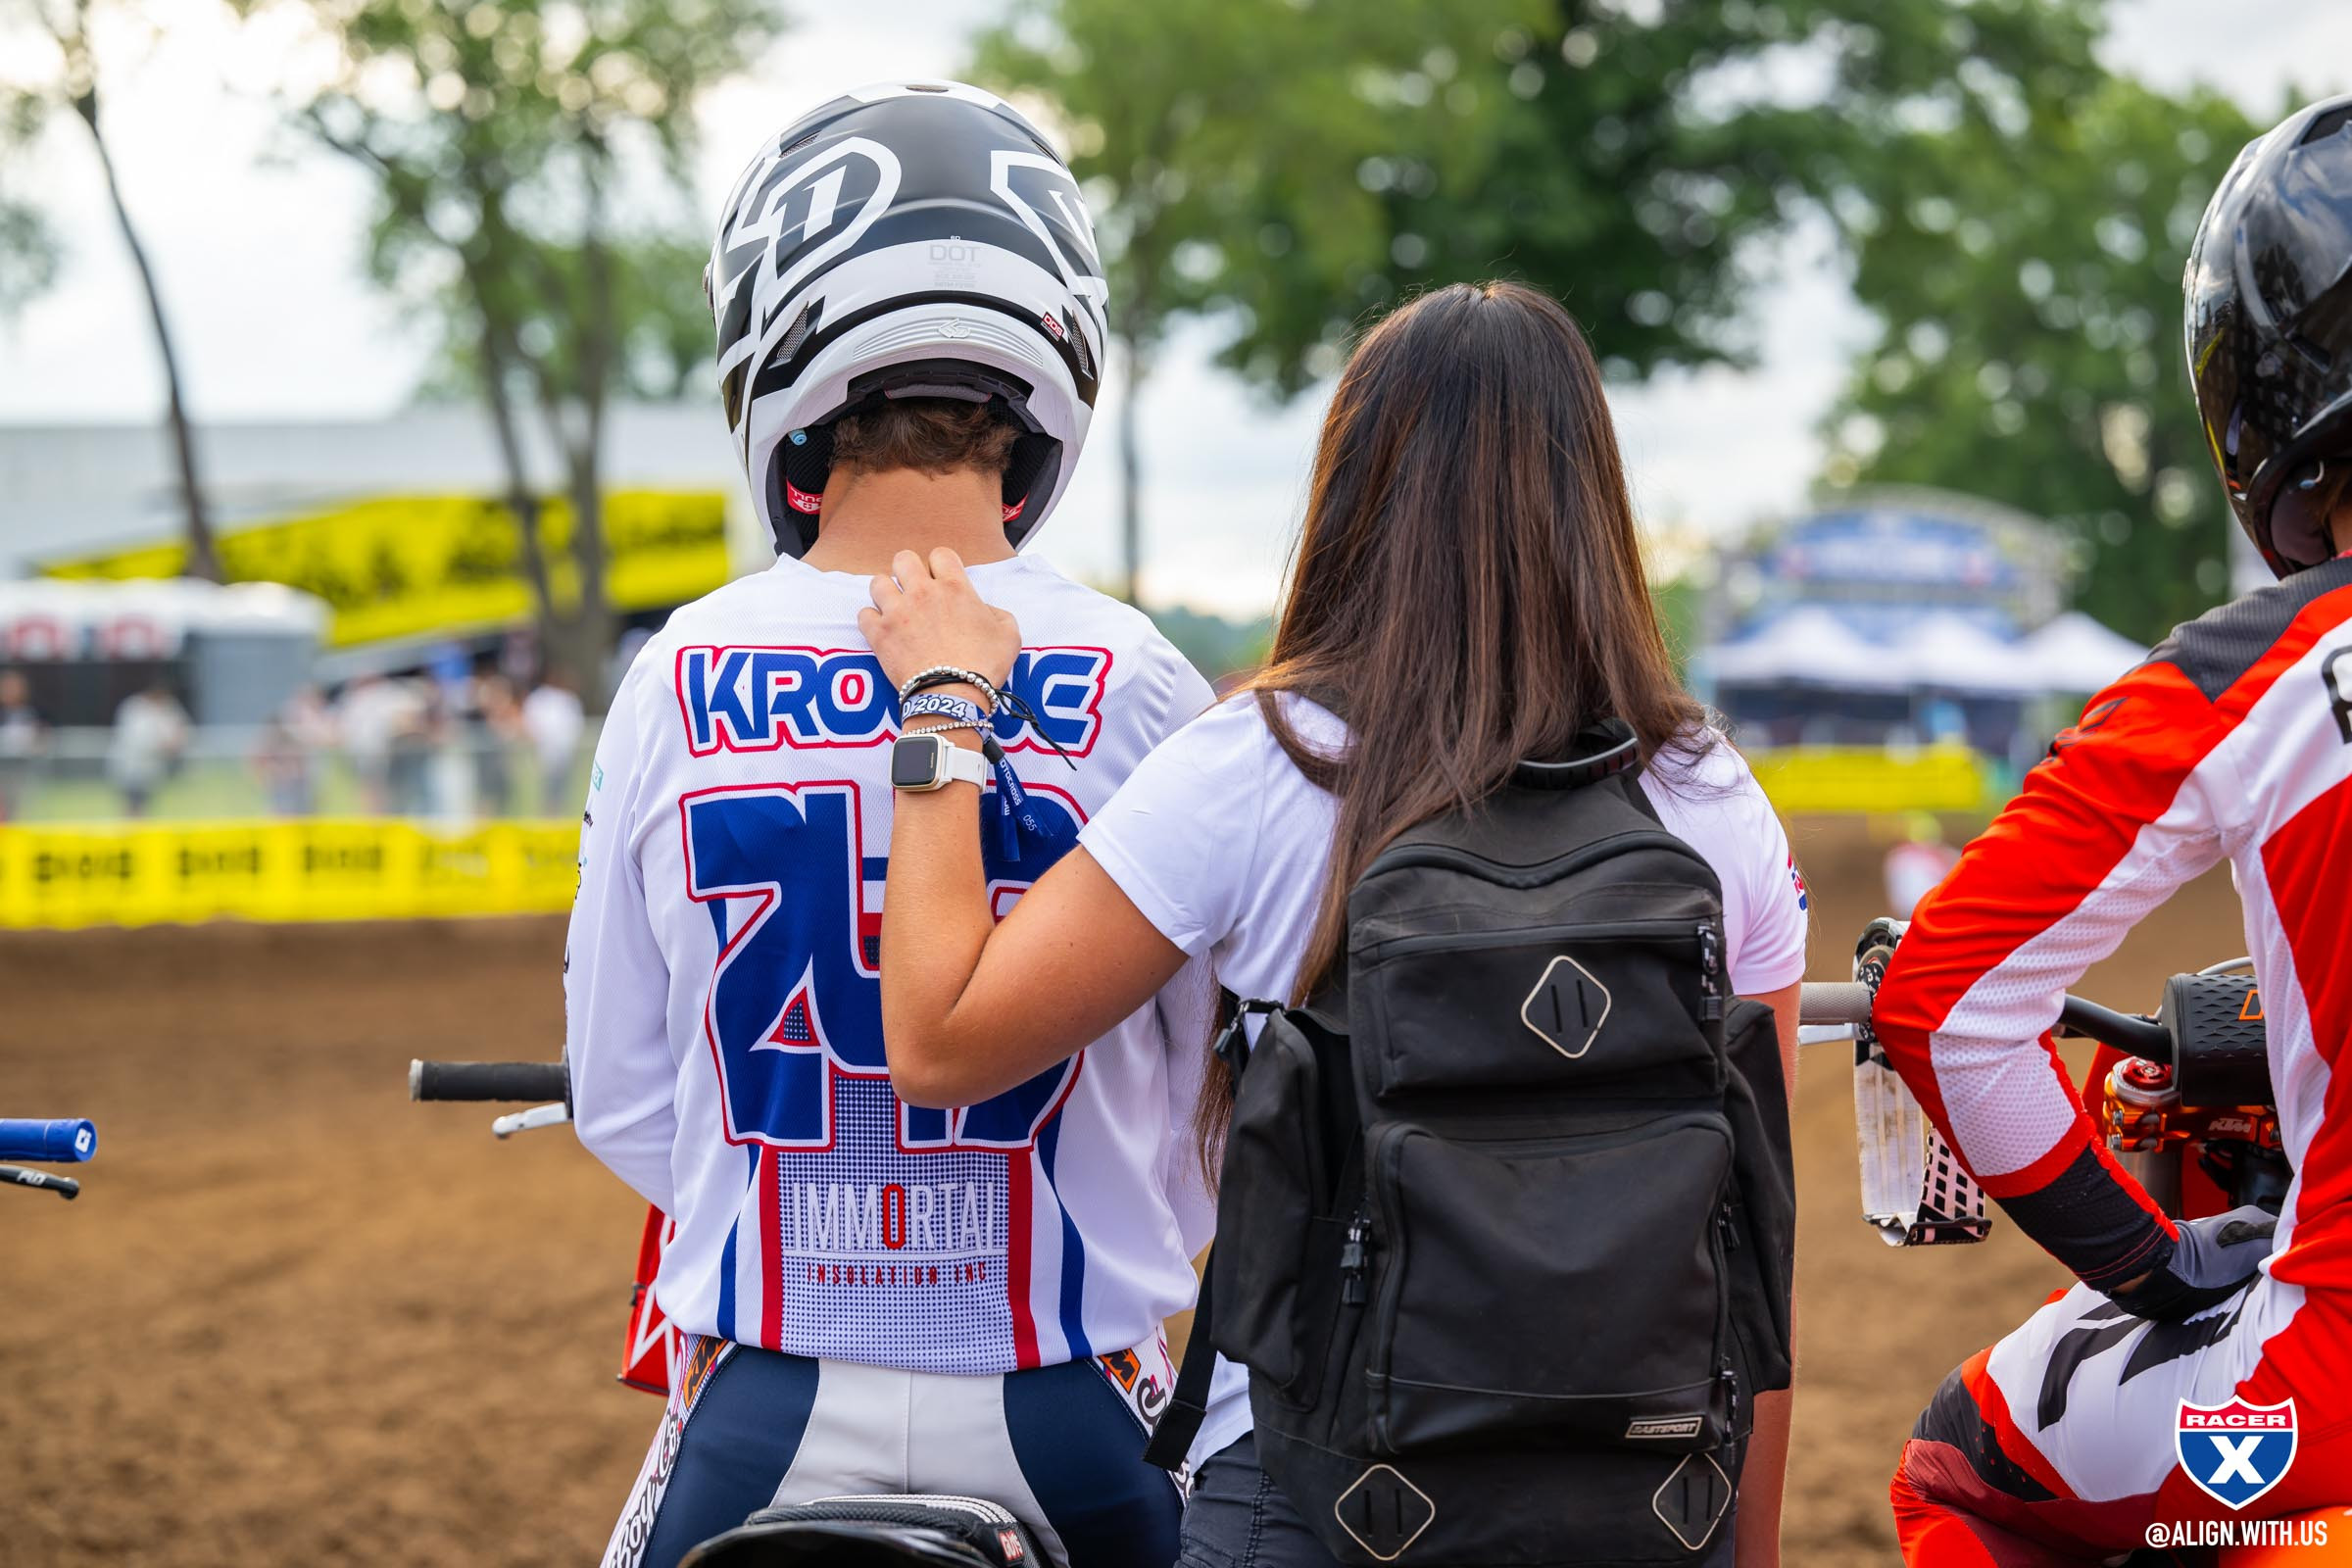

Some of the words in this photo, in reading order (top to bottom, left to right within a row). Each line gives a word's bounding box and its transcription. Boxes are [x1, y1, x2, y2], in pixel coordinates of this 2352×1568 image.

[929, 244, 982, 262] DOT
[680, 647, 1109, 755] KROE
[913, 697, 967, 718] 2024
[1022, 814, 1038, 831] 055
[807, 1264, 938, 1286] INSULATION
